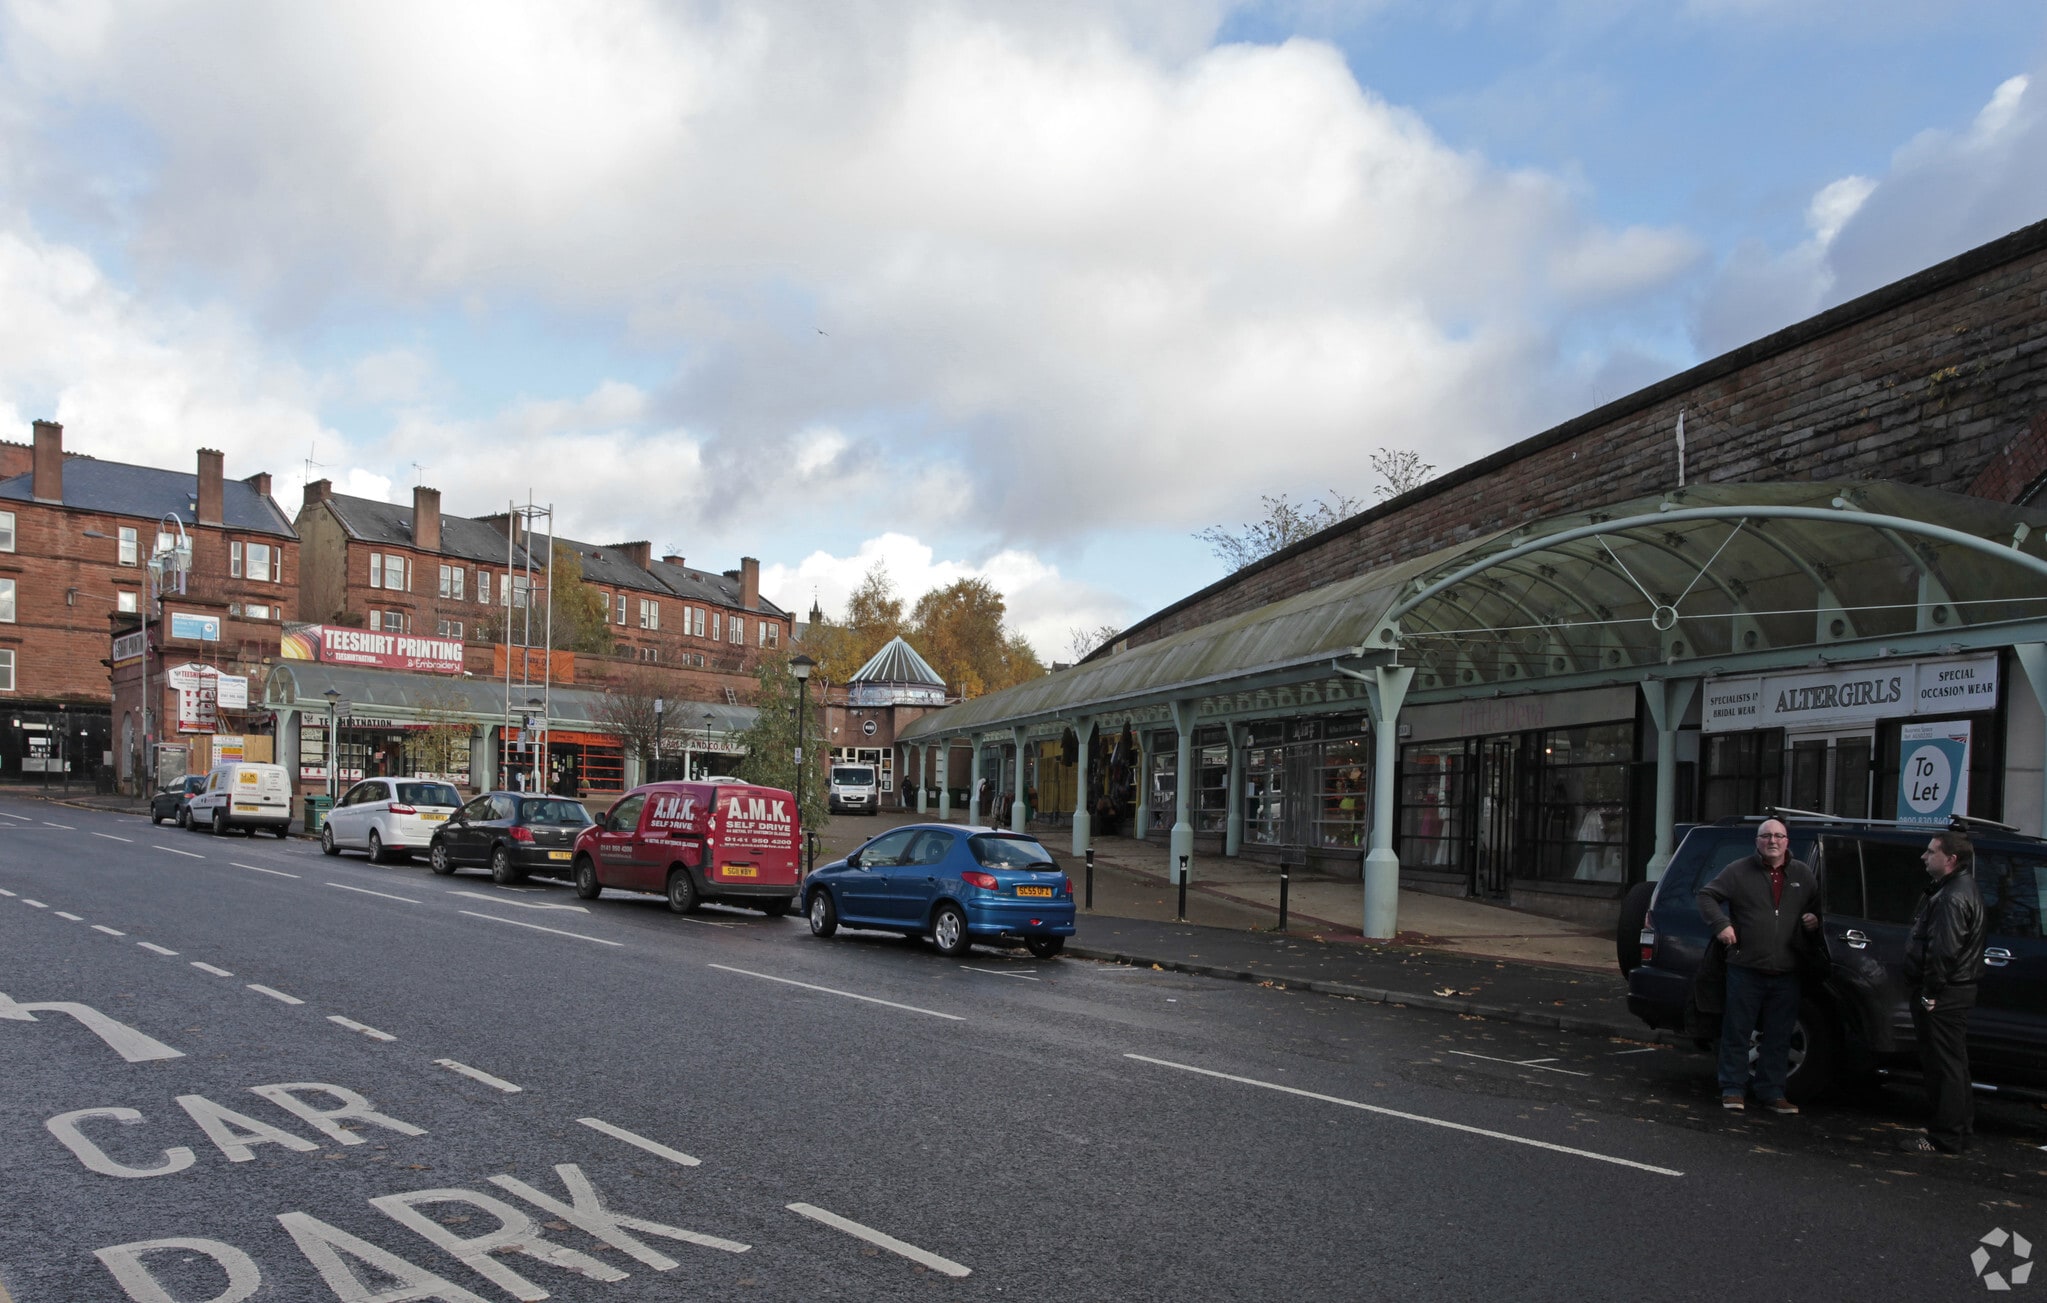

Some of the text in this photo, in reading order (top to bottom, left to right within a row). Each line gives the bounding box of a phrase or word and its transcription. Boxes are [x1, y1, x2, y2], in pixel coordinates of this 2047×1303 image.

[323, 629, 463, 662] TEESHIRT PRINTING
[407, 659, 461, 672] & Embroidery
[1938, 668, 1975, 682] SPECIAL
[1710, 693, 1751, 706] SPECIALISTS
[1775, 676, 1902, 713] ALTERGIRLS
[1921, 682, 1993, 699] OCCASION WEAR
[1713, 705, 1756, 718] BRIDAL WEAR
[1915, 757, 1934, 777] To
[1912, 781, 1939, 801] Let
[727, 797, 791, 823] A.M.K.
[650, 819, 669, 828] SELF
[726, 820, 791, 832] SELF DRIVE
[46, 1082, 429, 1178] CAR
[93, 1163, 753, 1303] PARK
